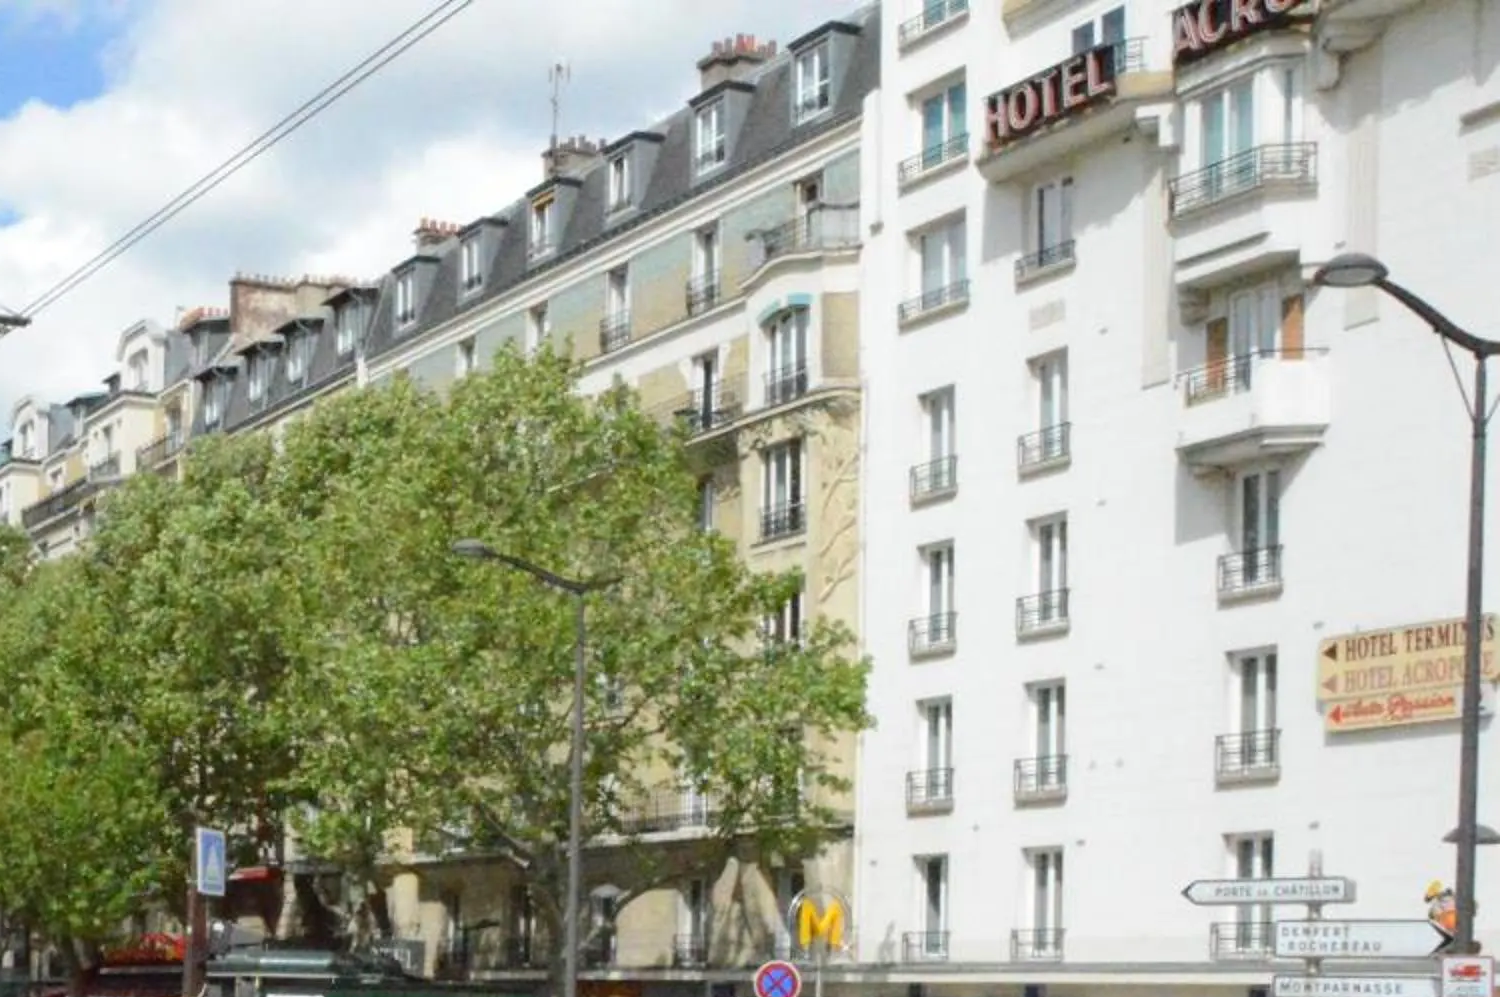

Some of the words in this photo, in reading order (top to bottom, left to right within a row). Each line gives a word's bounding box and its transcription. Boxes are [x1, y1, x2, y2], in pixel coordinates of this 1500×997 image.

[985, 50, 1109, 142] HOTEL
[1344, 632, 1398, 662] HOTEL
[1404, 615, 1495, 652] TERMIS
[1344, 665, 1396, 692] HOTEL
[1402, 651, 1493, 687] ACROPE
[799, 895, 844, 951] M
[1281, 925, 1350, 937] DENFERT
[1280, 982, 1403, 995] MONTPARNASSE
